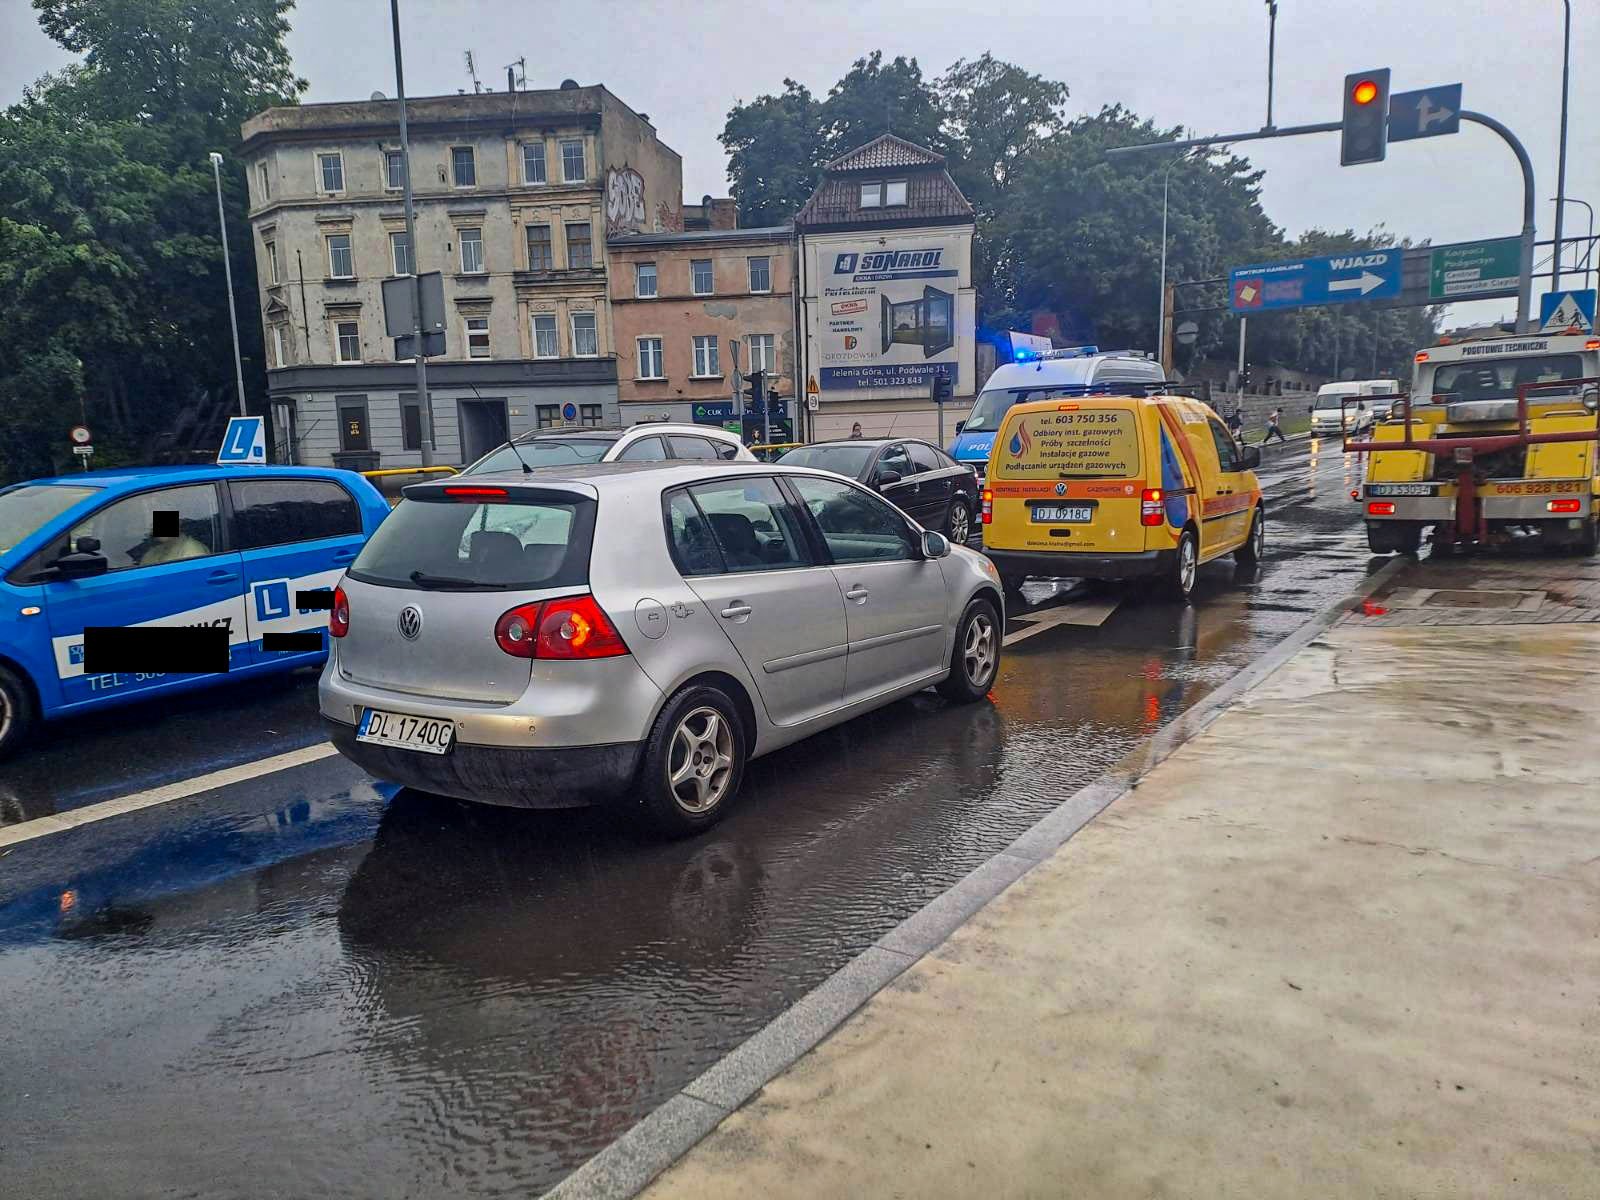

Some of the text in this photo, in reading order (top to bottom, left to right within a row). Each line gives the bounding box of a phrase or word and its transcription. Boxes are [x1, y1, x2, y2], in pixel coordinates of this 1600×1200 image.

[860, 249, 943, 273] SONAROL
[1329, 254, 1388, 271] WJAZD
[832, 369, 860, 377] Jelenia
[862, 367, 884, 376] Góra,
[886, 367, 897, 375] ul.
[898, 366, 934, 375] Podwale
[873, 378, 889, 386] 501
[890, 377, 906, 385] 323
[907, 376, 922, 384] 843
[1040, 414, 1118, 425] tel. 603 750 356
[1082, 428, 1123, 436] gazowych
[231, 426, 244, 454] L
[1041, 438, 1111, 448] Próby szczelności
[1040, 451, 1110, 459] Instalacje gazowe
[1005, 463, 1047, 471] Podłączanie
[1085, 462, 1126, 470] gazowych
[1038, 508, 1089, 520] DJ 0918C
[262, 588, 283, 616] L
[87, 673, 129, 691] TEL:
[367, 713, 452, 747] DL 1740C
